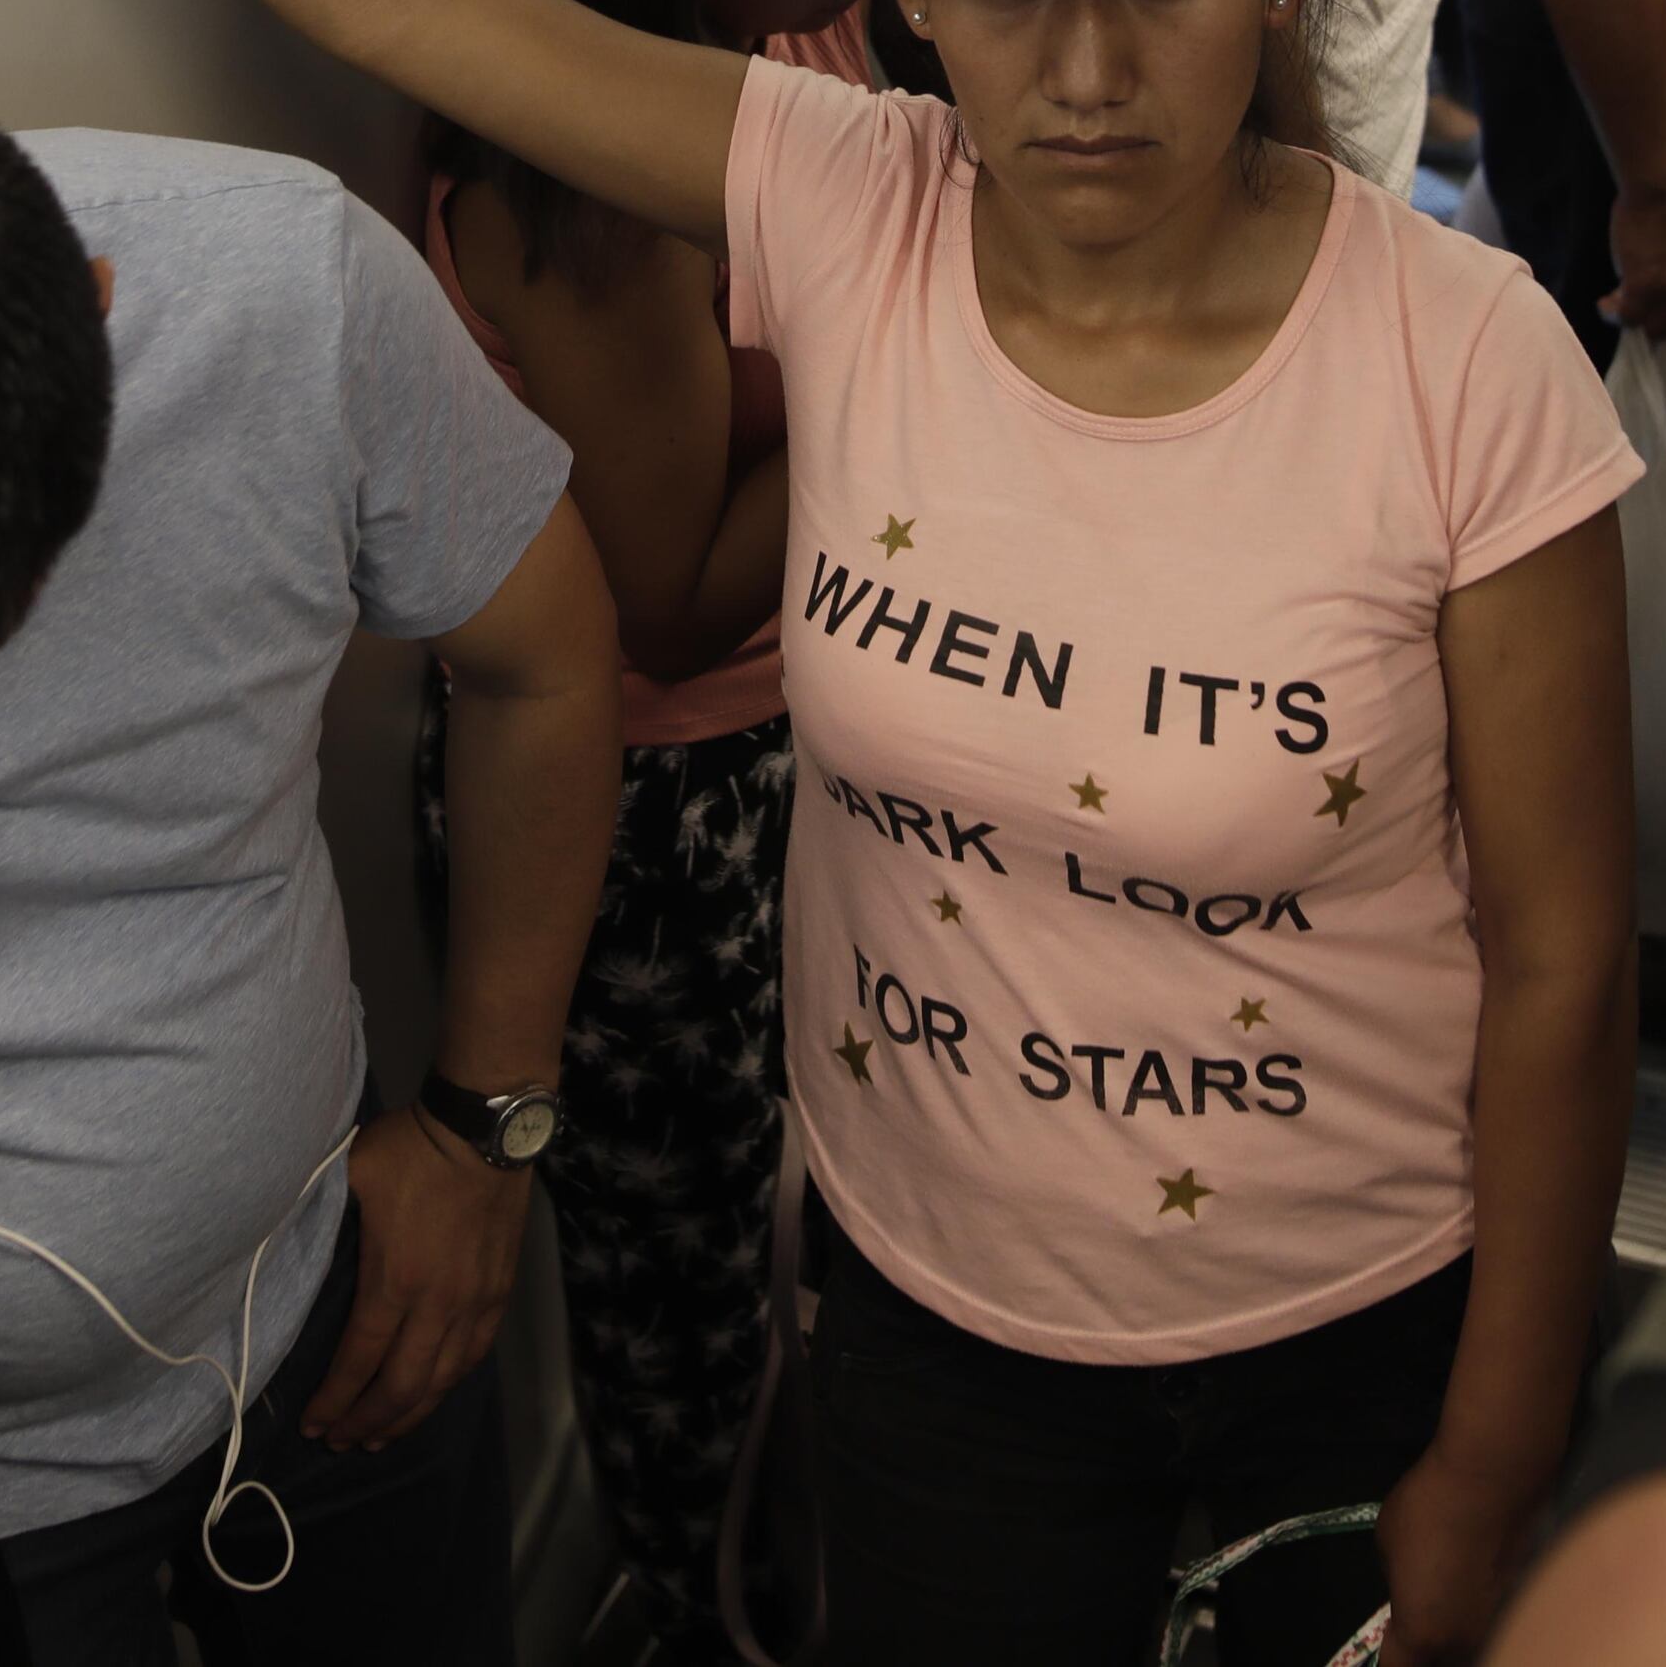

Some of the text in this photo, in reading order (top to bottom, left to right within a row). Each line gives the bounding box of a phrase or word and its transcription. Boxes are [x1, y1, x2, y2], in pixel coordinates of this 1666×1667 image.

[803, 551, 1329, 755] WHEN IT'S
[1064, 852, 1314, 936] LOOK
[853, 943, 1307, 1117] FOR STARS
